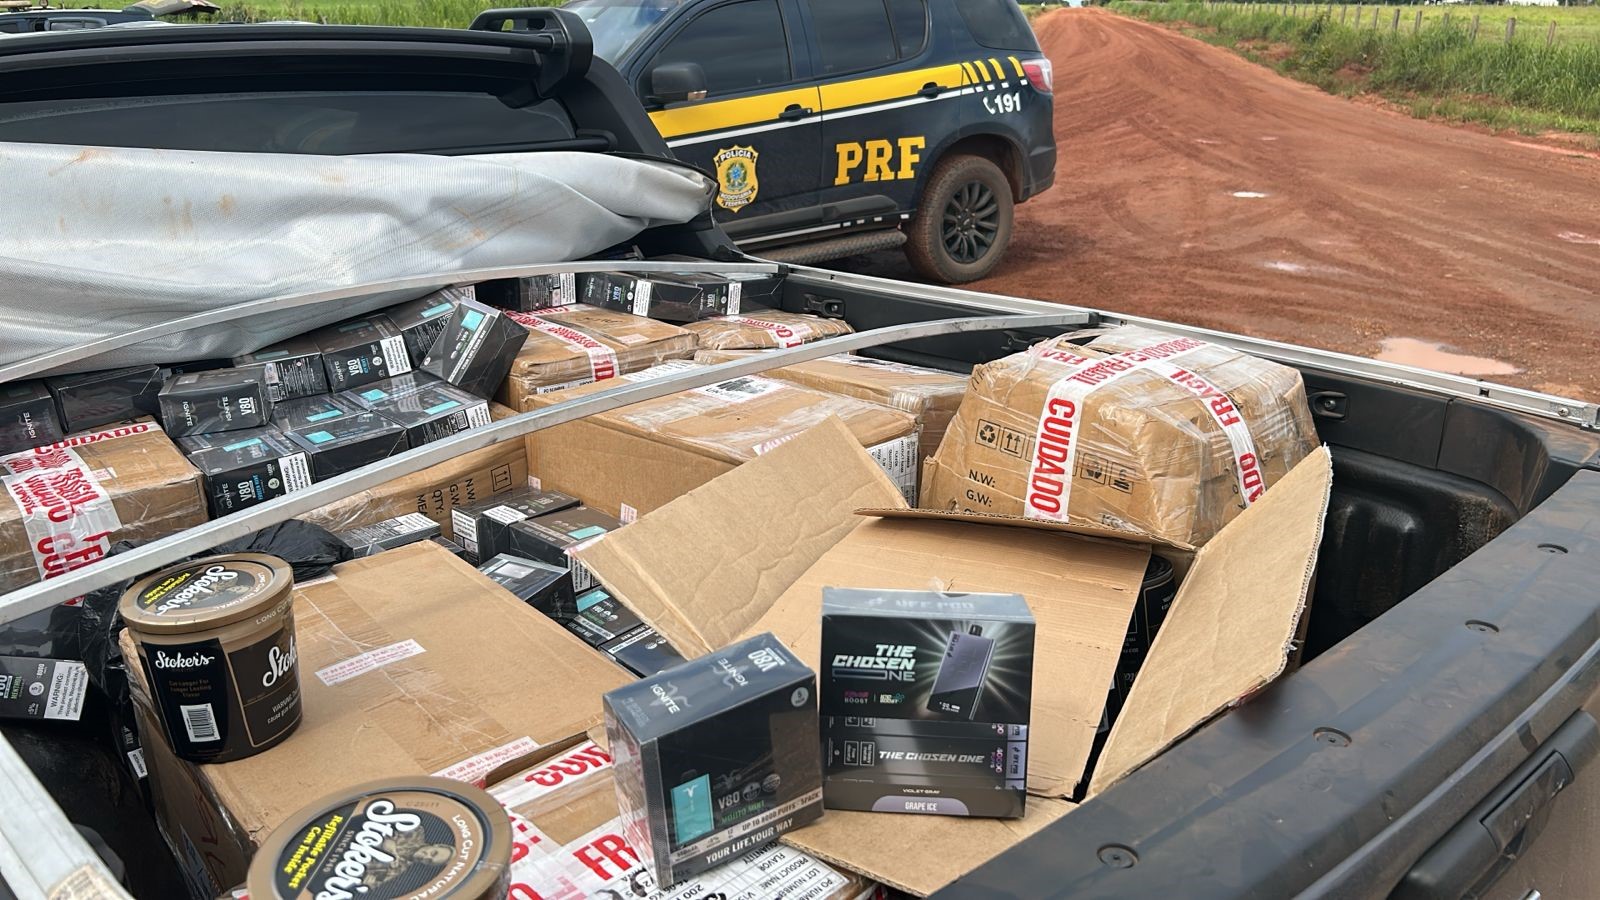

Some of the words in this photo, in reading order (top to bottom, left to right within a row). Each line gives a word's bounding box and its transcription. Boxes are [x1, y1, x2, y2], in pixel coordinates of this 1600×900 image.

[994, 92, 1021, 114] 191
[834, 136, 926, 186] PRF
[347, 359, 360, 376] V80
[239, 397, 252, 416] V80
[34, 423, 149, 455] CUIDADO
[1029, 398, 1076, 513] CUIDADO
[968, 468, 997, 489] N.W:
[222, 482, 233, 509] IGNITE
[237, 481, 251, 502] V80
[431, 489, 444, 515] QTY:
[966, 488, 993, 508] G.W:
[255, 610, 276, 625] LONG
[155, 650, 216, 669] Stoker's
[748, 649, 779, 673] V80
[875, 643, 917, 658] THE
[718, 657, 749, 687] IGNITE
[832, 655, 916, 671] CHOSEN
[50, 673, 64, 708] WARNING:
[650, 683, 681, 715] IGNITE
[878, 750, 903, 760] THE
[905, 752, 956, 763] CHOSEN
[958, 754, 985, 764] ONE
[718, 791, 740, 809] V80
[905, 801, 925, 811] GRAPE
[926, 802, 938, 812] ICE
[303, 826, 321, 844] Can
[310, 815, 344, 857] Refillable
[452, 814, 472, 839] LONG
[460, 839, 474, 860] CUT
[705, 849, 730, 865] YOUR
[776, 818, 794, 833] WAY
[283, 844, 310, 874] Inside
[742, 840, 778, 865] QUANTITY
[759, 852, 786, 872] FLAVOR
[288, 856, 316, 889] Pocket
[780, 856, 809, 879] PRODUCT
[806, 867, 821, 880] LOT
[682, 884, 704, 899] 200
[760, 875, 780, 890] NAME
[820, 878, 833, 888] PO
